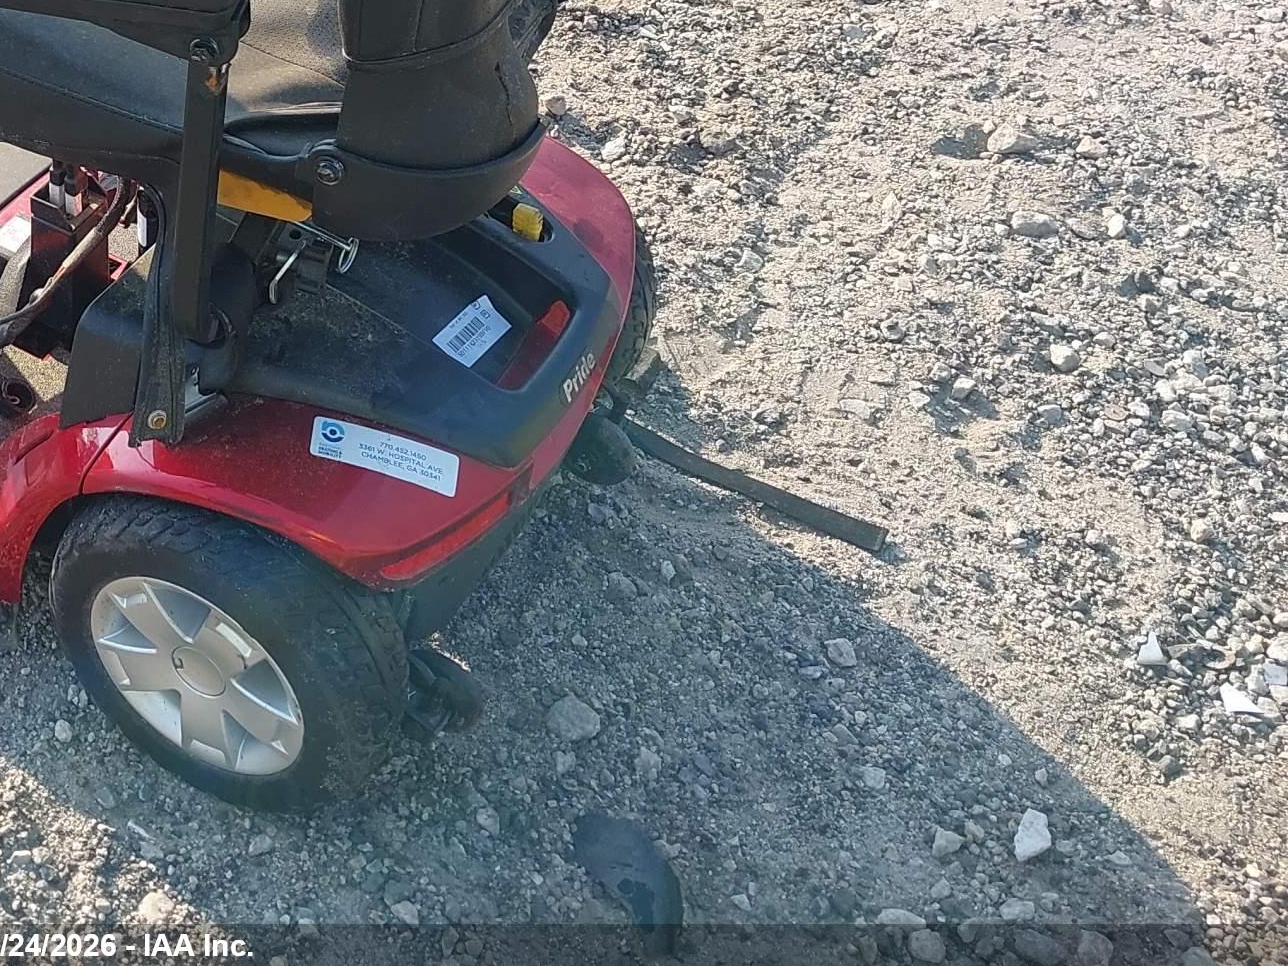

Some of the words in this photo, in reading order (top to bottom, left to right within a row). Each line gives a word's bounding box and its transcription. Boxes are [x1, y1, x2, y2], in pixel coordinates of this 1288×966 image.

[563, 353, 596, 403] Pride
[388, 451, 426, 469] HOSPITAL
[406, 464, 418, 473] GA
